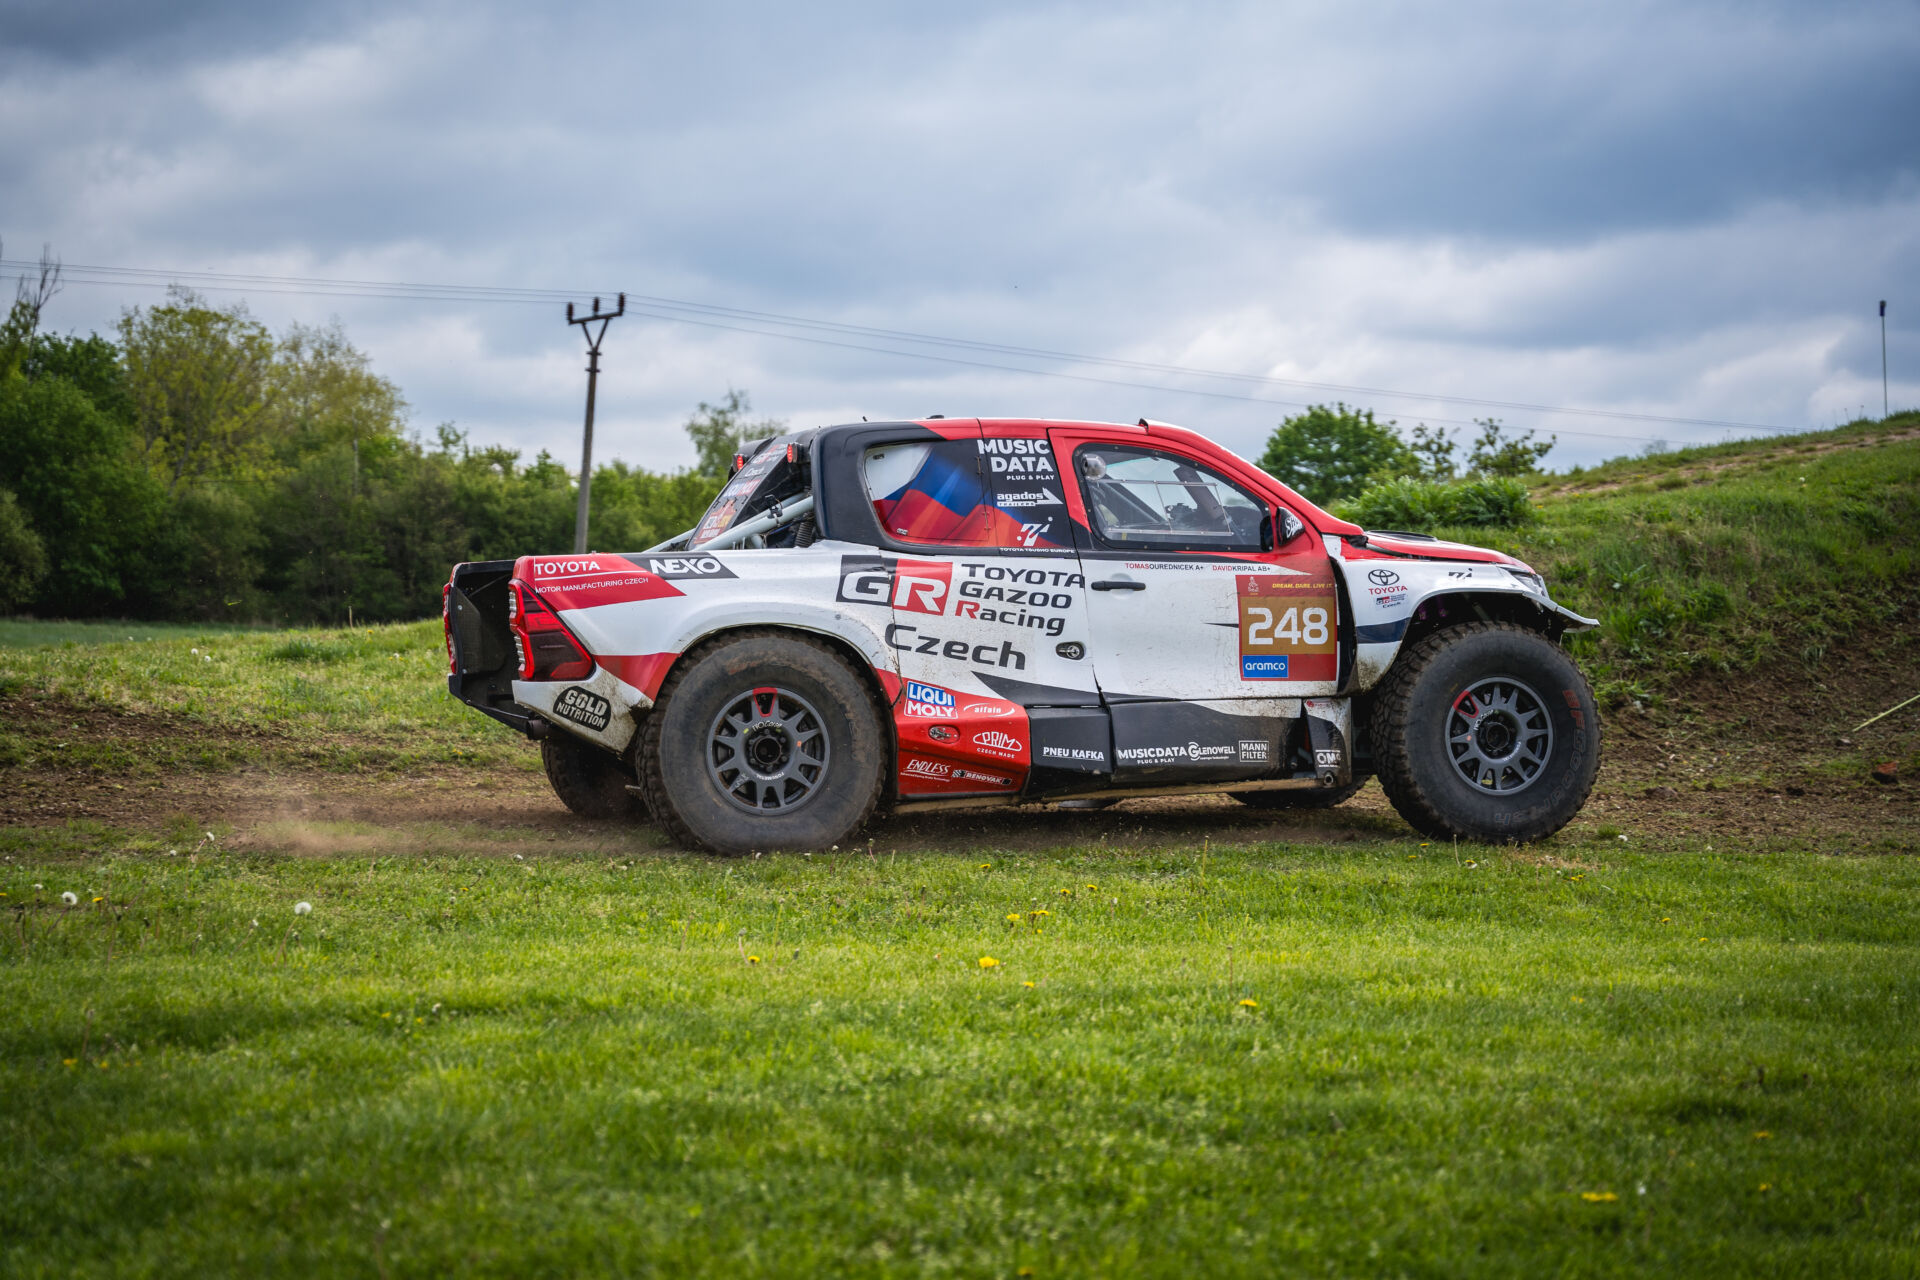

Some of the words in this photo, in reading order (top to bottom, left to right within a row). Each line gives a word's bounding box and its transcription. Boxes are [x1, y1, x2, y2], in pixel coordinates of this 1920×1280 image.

[977, 439, 1050, 454] MUSIC
[990, 456, 1054, 472] DATA
[996, 491, 1044, 502] agados
[535, 561, 601, 575] TOYOTA
[649, 557, 722, 575] NEXO
[961, 563, 1086, 589] TOYOTA
[535, 585, 562, 594] MOTOR
[562, 579, 623, 592] MANUFACTURING
[624, 577, 649, 585] CZECH
[841, 571, 947, 613] GR
[1368, 585, 1408, 595] TOYOTA
[959, 581, 1073, 609] GAZOO
[955, 600, 1066, 637] Racing
[1247, 607, 1328, 645] 248
[885, 623, 1026, 671] Czech
[1245, 662, 1286, 671] aramco
[563, 688, 608, 717] GOLD
[908, 684, 953, 706] LIQUI
[556, 702, 606, 730] NUTRITION
[907, 700, 954, 718] MOLY
[981, 731, 1016, 749] PRIM
[1241, 743, 1267, 751] MANN
[976, 747, 997, 755] CZECH
[998, 751, 1015, 759] MADE
[1043, 746, 1071, 757] PNEU
[1072, 749, 1105, 760] KAFKA
[1118, 746, 1188, 760] MUSICDATA
[1241, 751, 1267, 760] FILTER
[906, 759, 951, 775] ENDLESS
[965, 772, 1002, 784] RENOVAK
